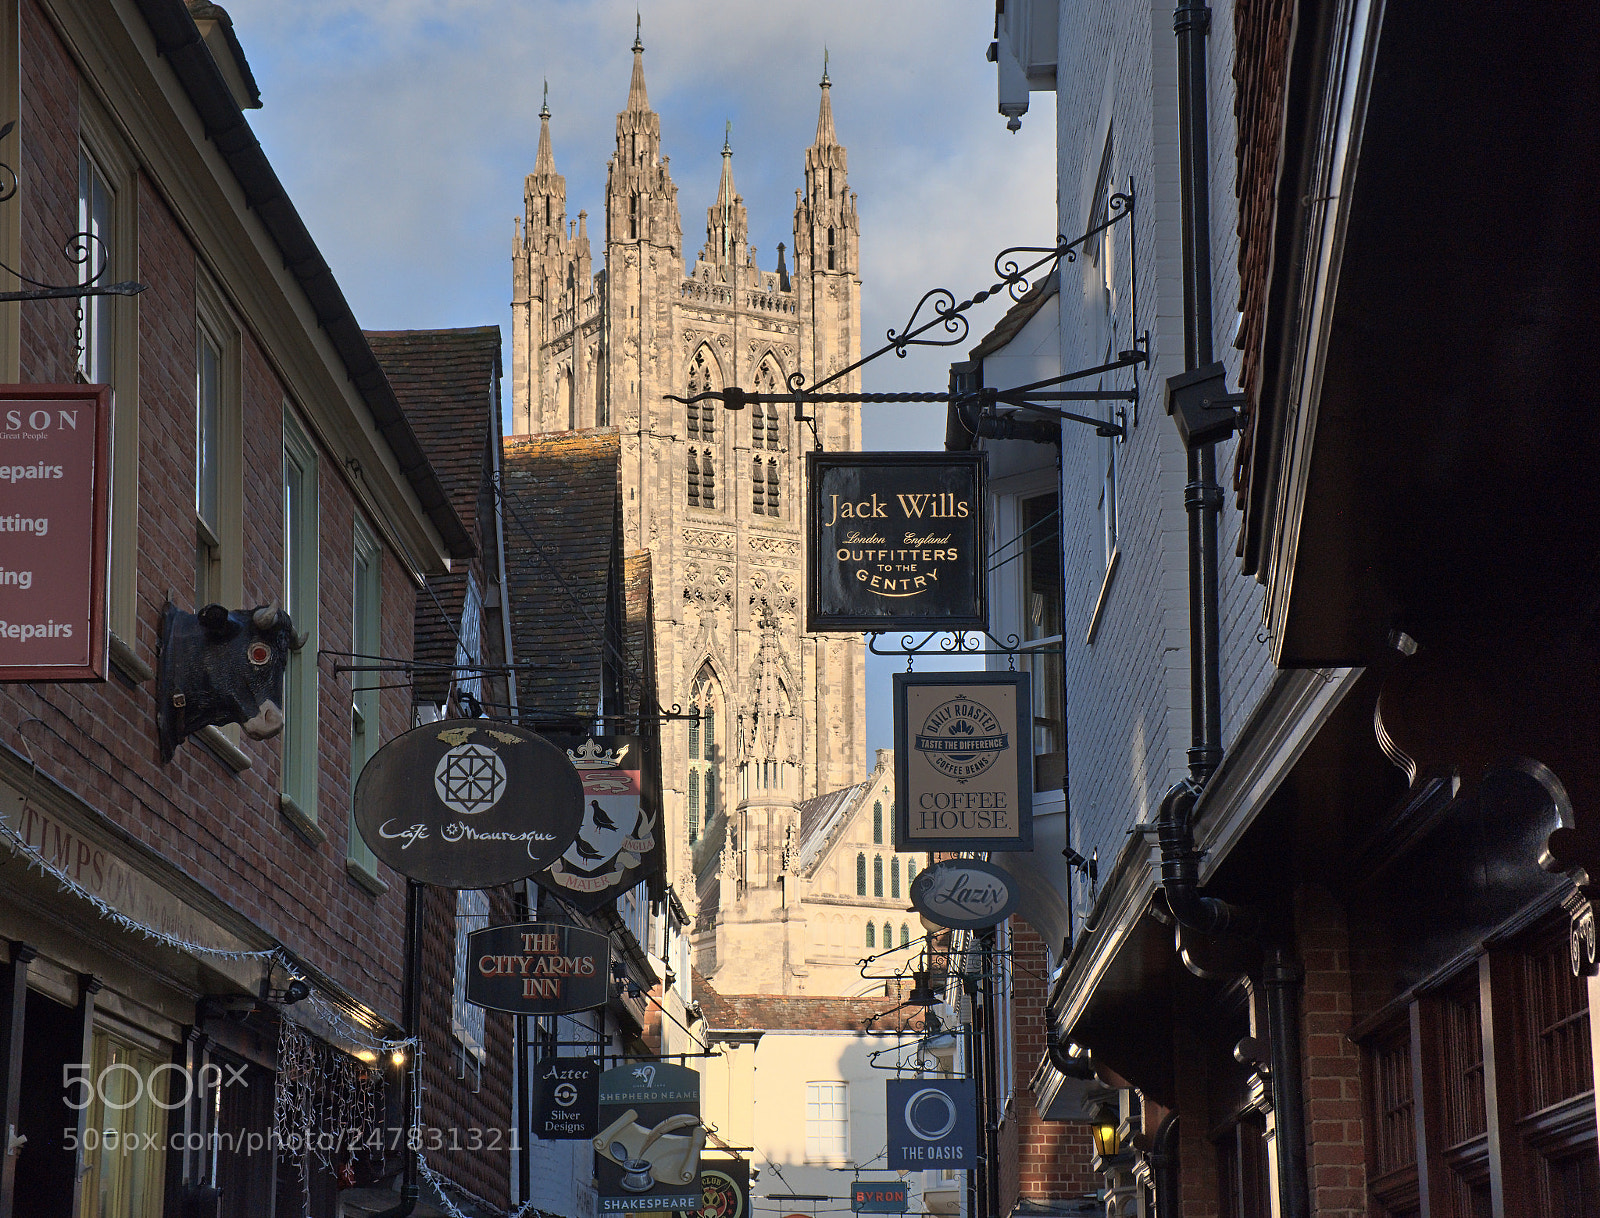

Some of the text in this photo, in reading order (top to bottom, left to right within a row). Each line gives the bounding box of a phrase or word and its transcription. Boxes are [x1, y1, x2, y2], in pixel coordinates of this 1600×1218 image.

[22, 432, 48, 441] People
[825, 493, 969, 527] Jack Wills
[842, 531, 951, 547] London England
[836, 548, 958, 561] OUTFITTERS
[877, 563, 917, 572] TO THE
[855, 568, 938, 591] GENTRY
[926, 704, 996, 733] DAILY ROASTED
[921, 738, 1003, 750] TASTE THE DIFFERENCE
[935, 757, 989, 775] COFFEE BEANS
[919, 792, 1007, 810] COFFEE
[918, 811, 1008, 830] HOUSE
[440, 820, 557, 860] Mauresque
[24, 805, 139, 911] TIMPSON
[565, 875, 610, 890] MATER
[521, 932, 558, 953] THE
[479, 954, 595, 976] CITY ARMS
[522, 978, 560, 997] INN
[542, 1065, 589, 1079] Aztec
[600, 1091, 698, 1101] SHEPHERD NEAME
[551, 1110, 581, 1120] Silver
[545, 1121, 585, 1134] Designs
[901, 1146, 963, 1160] THE OASIS
[702, 1177, 721, 1186] CLUB
[604, 1198, 695, 1210] SHAKESPEARE
[856, 1191, 904, 1202] BYRON
